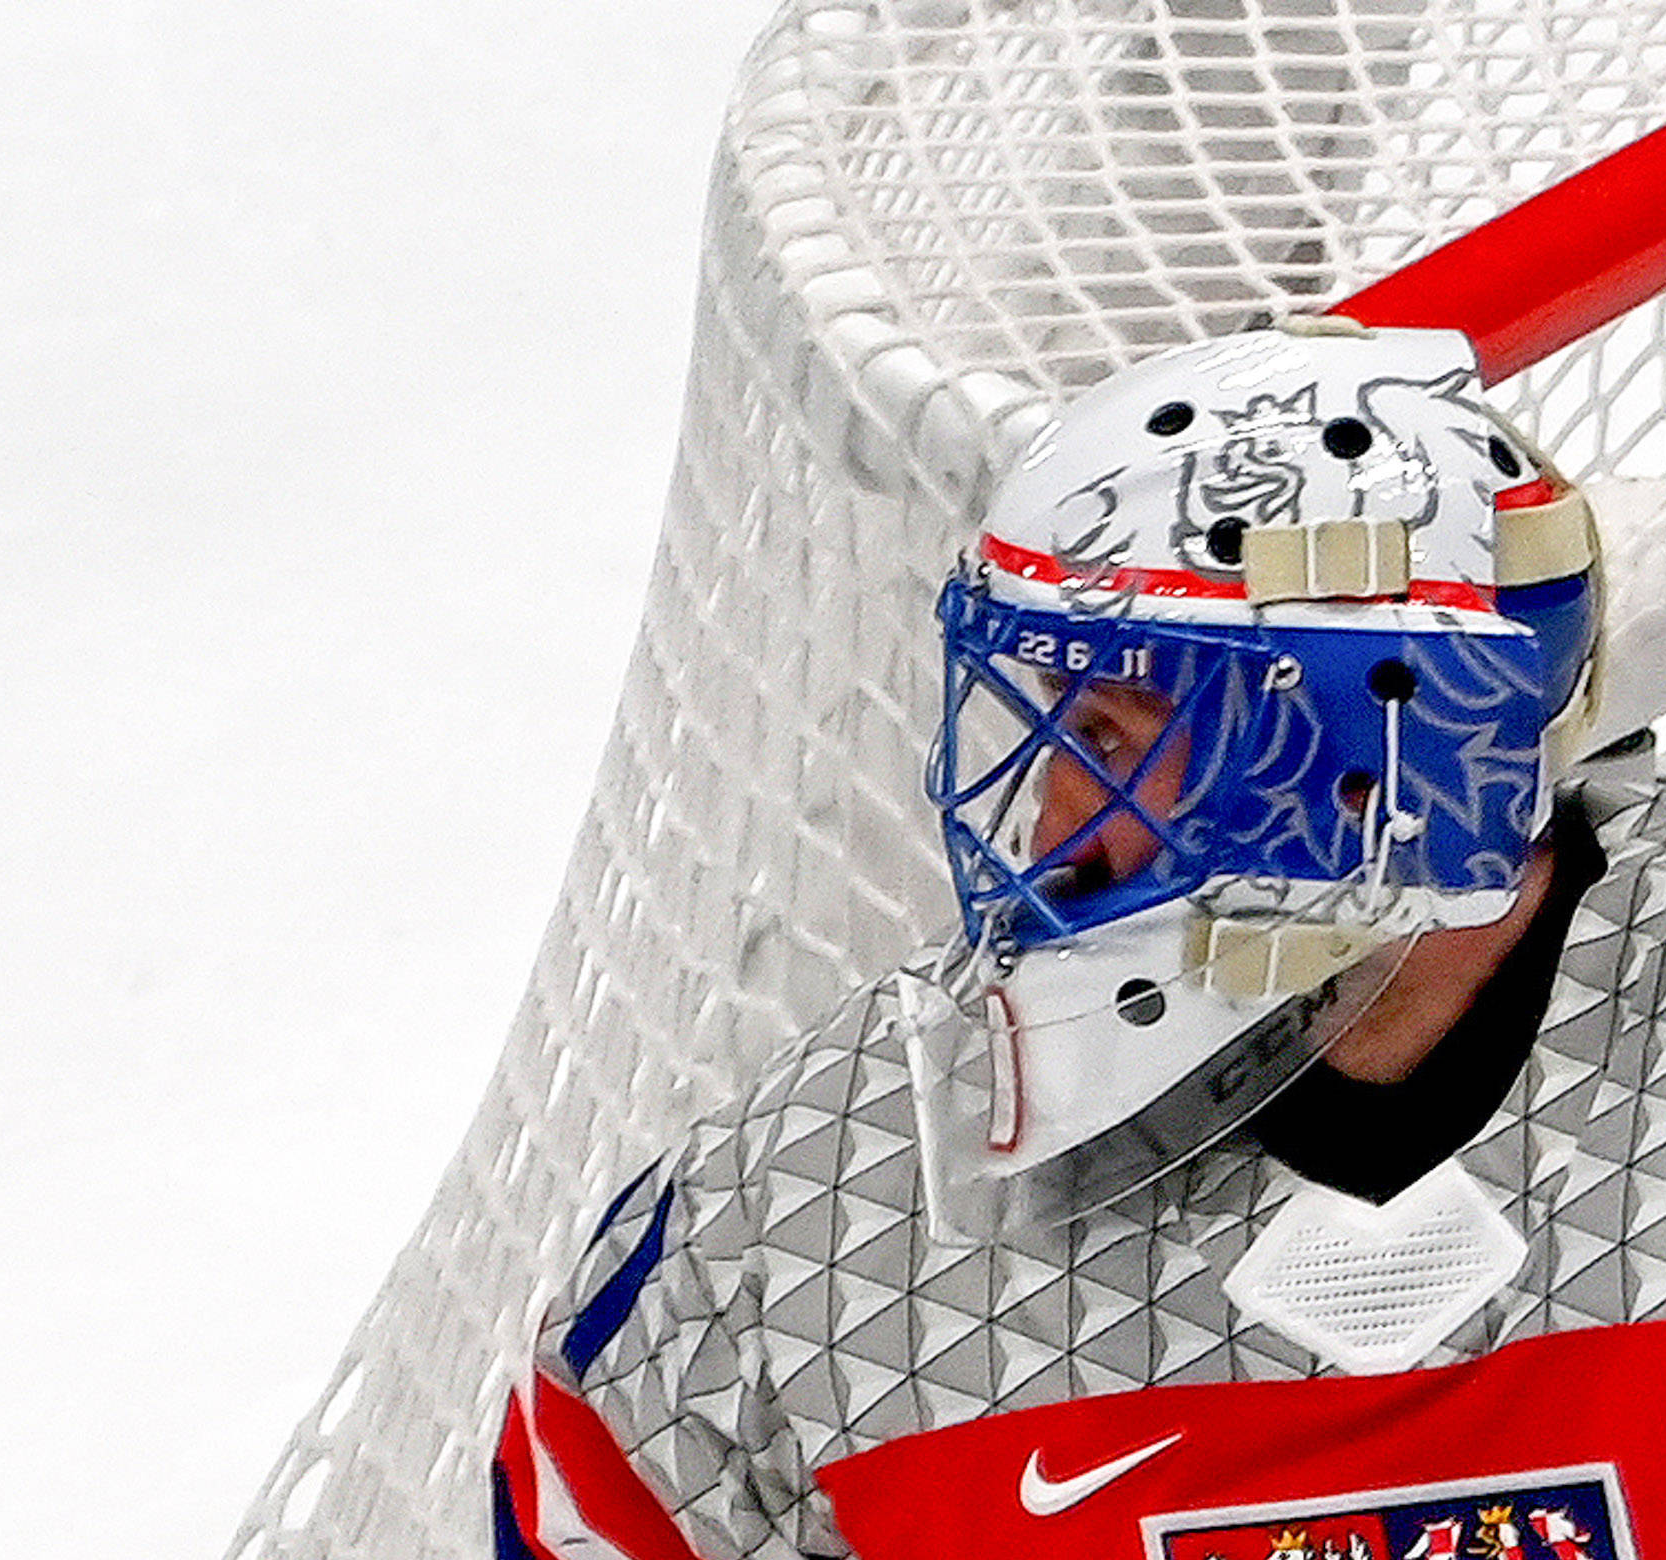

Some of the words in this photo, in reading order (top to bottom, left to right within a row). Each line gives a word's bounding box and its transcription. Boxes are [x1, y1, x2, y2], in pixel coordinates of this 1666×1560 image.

[1018, 630, 1057, 665] 22
[1066, 641, 1092, 671] 6
[1122, 648, 1151, 678] 11
